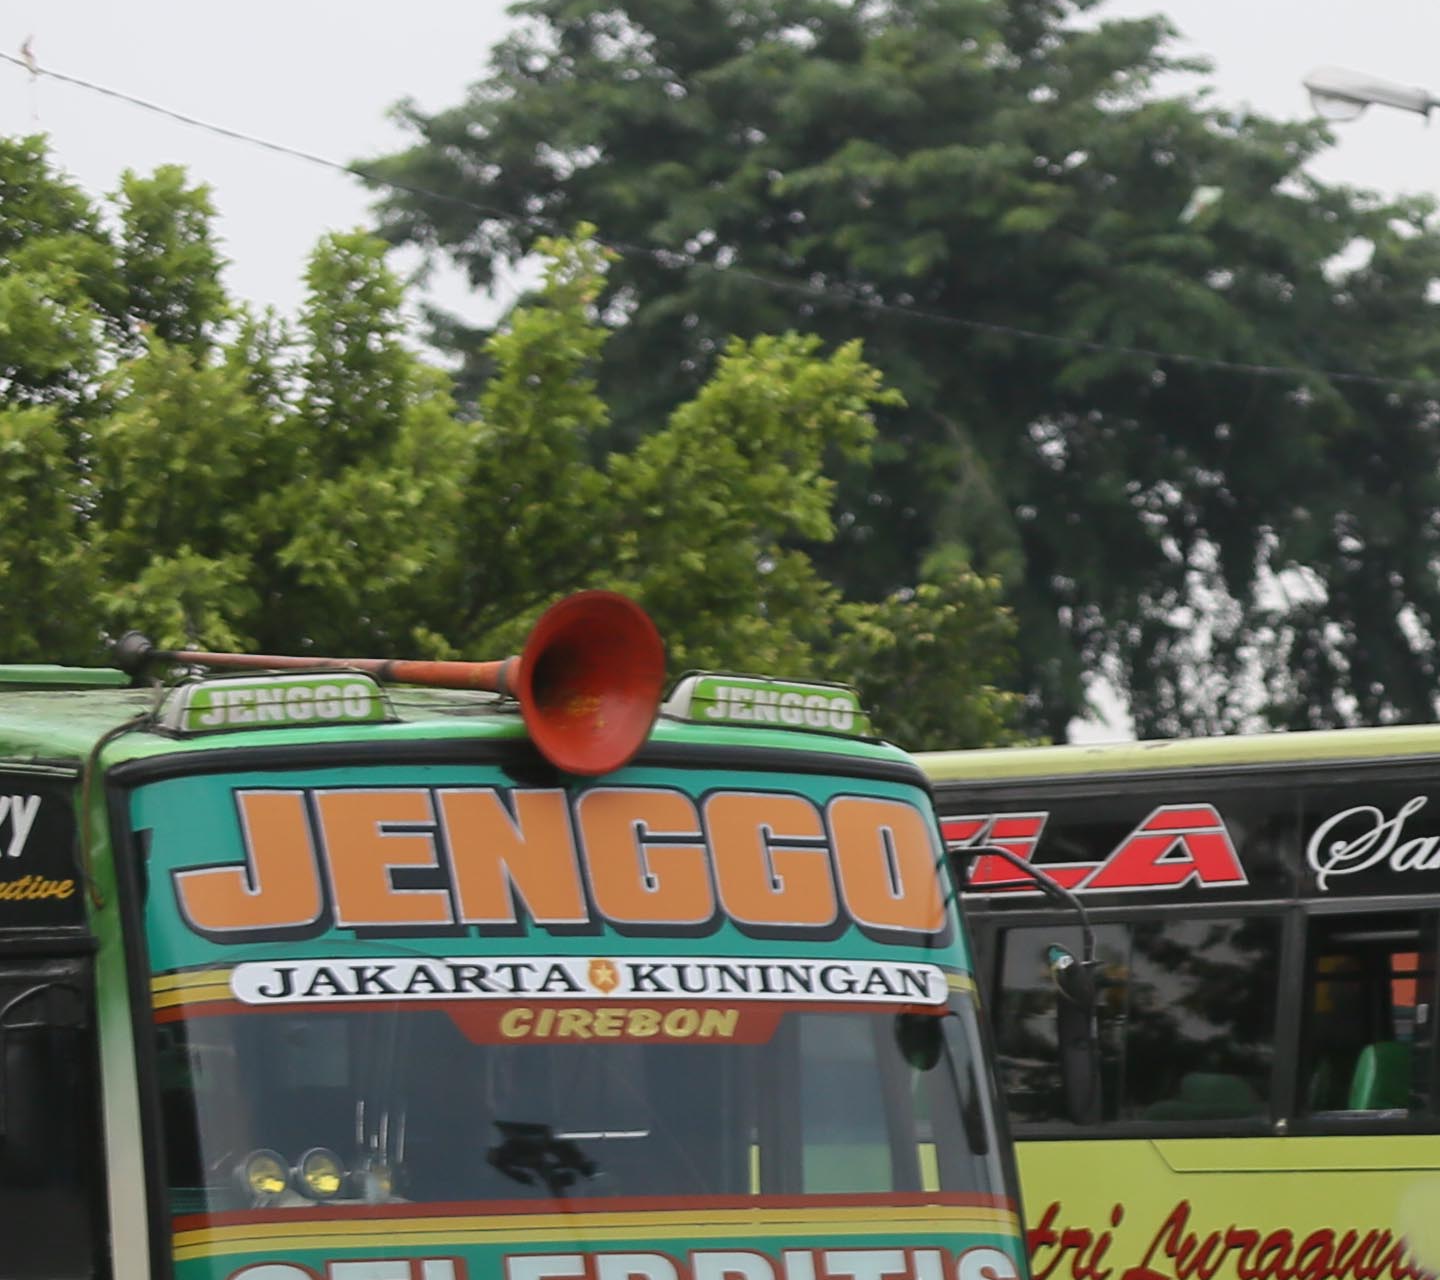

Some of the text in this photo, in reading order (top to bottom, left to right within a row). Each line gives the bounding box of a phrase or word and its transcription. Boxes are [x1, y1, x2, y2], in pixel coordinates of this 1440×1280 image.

[202, 683, 373, 724] JENGGO
[706, 686, 853, 730] JENGGO
[173, 786, 950, 934] JENGGO
[258, 959, 931, 1003] JAKARTA KUNINGAN
[500, 1006, 738, 1039] CIREBON
